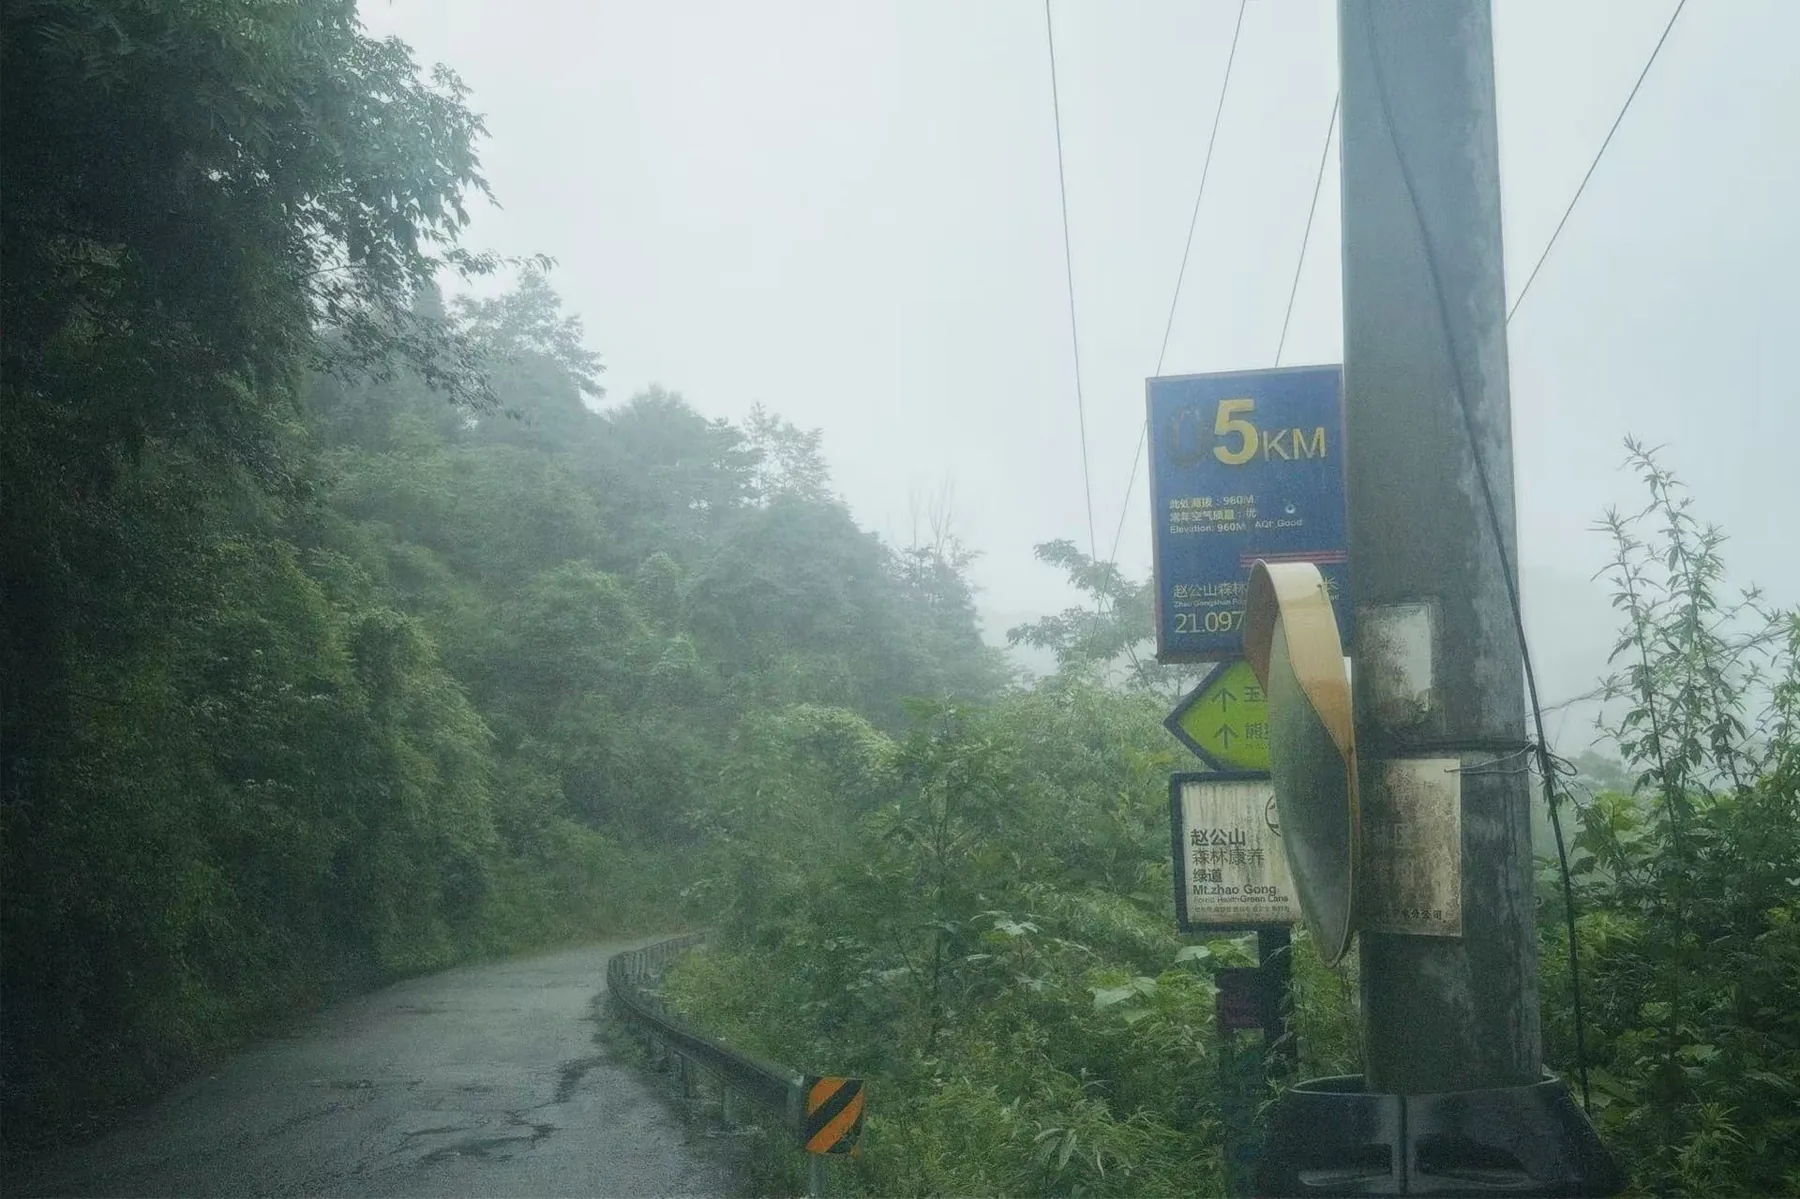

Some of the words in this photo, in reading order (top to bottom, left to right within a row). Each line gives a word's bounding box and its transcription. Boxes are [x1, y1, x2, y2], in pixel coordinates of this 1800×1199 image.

[1277, 517, 1303, 528] Good
[1190, 828, 1246, 847] 赵公山
[1192, 848, 1264, 866] 森林康养
[1193, 867, 1223, 883] 绿道
[1244, 884, 1277, 898] Gong
[1240, 895, 1266, 903] Green
